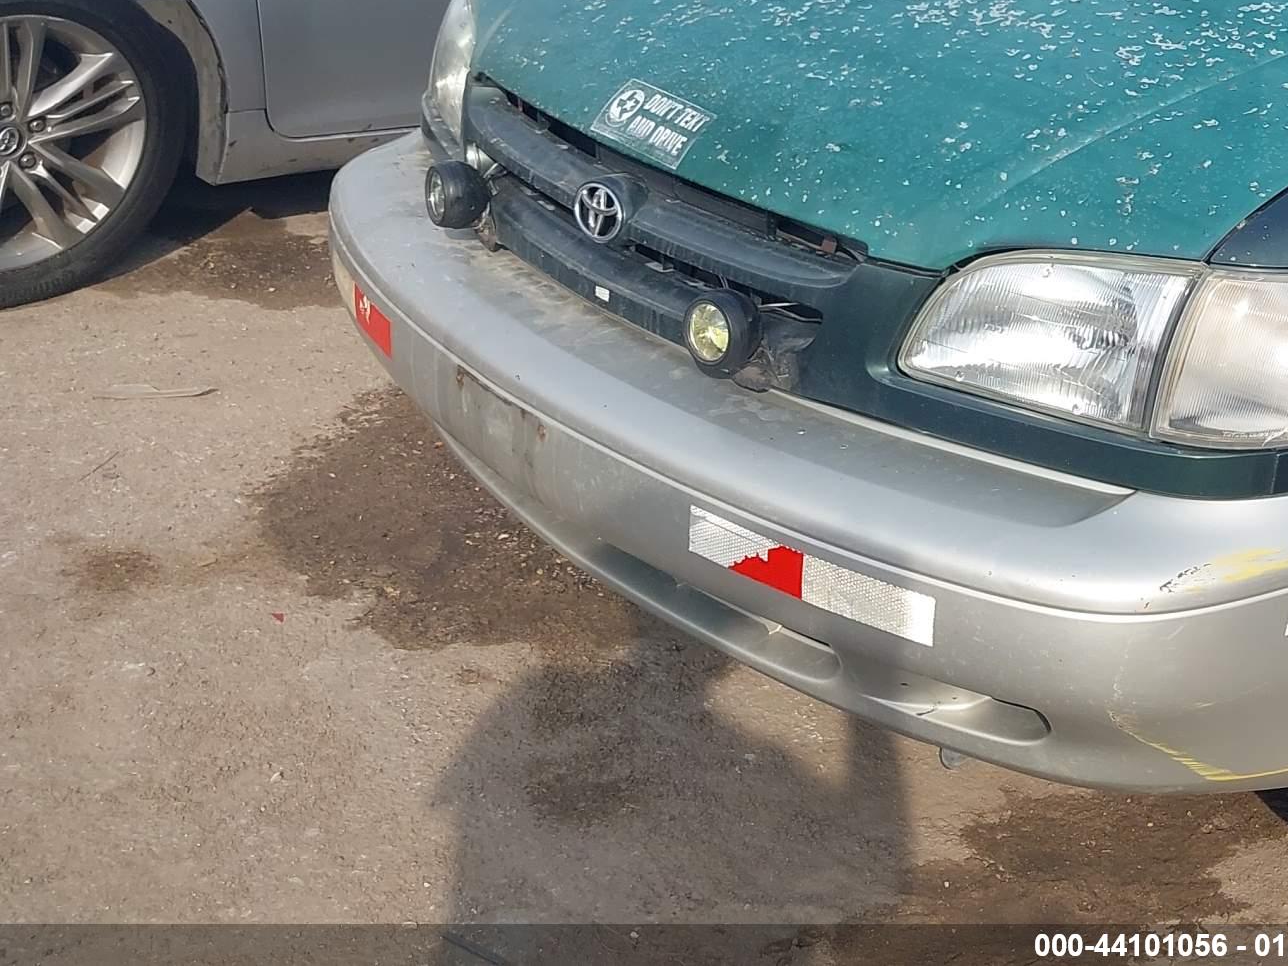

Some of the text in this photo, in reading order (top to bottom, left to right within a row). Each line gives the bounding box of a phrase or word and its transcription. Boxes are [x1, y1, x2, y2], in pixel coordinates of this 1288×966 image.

[642, 93, 711, 133] DON'T TEXT
[625, 115, 688, 156] AND DRIVE
